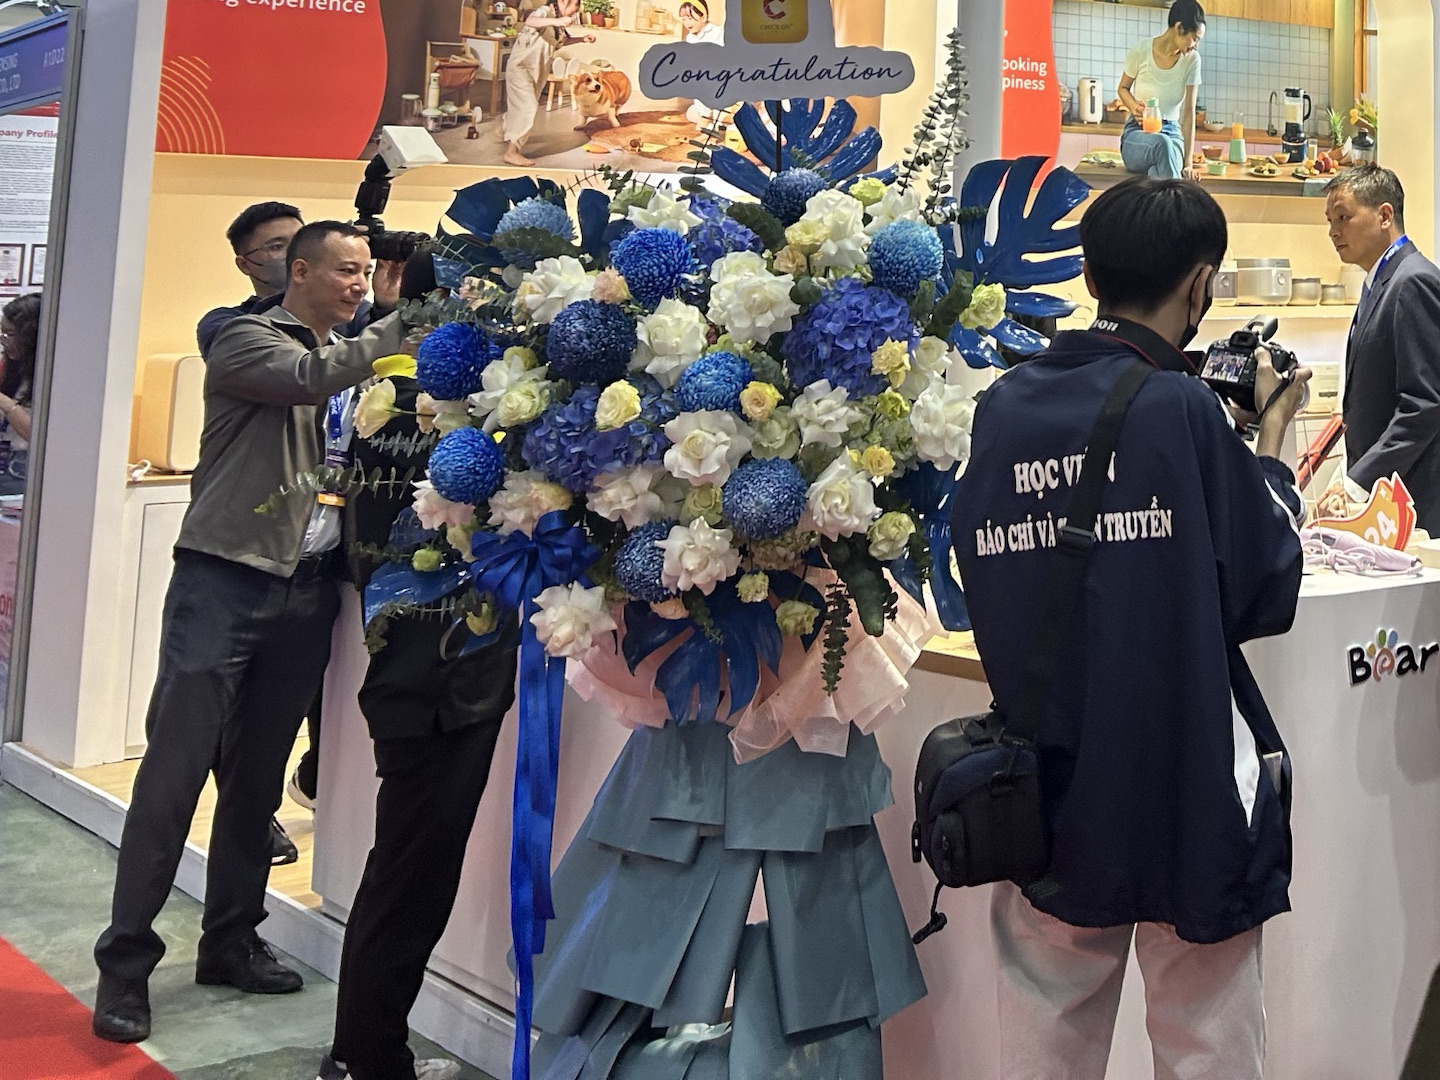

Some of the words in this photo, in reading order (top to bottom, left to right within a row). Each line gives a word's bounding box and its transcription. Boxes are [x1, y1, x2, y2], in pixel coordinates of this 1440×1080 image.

[651, 51, 904, 99] Congratulation
[1002, 56, 1047, 77] ooking
[1013, 458, 1059, 500] HỌC
[976, 519, 1005, 556] BÁO
[1007, 513, 1035, 552] CHÍ
[1036, 511, 1057, 548] VÀ
[1104, 495, 1173, 542] TRUYỀN
[1346, 627, 1440, 686] Bear
